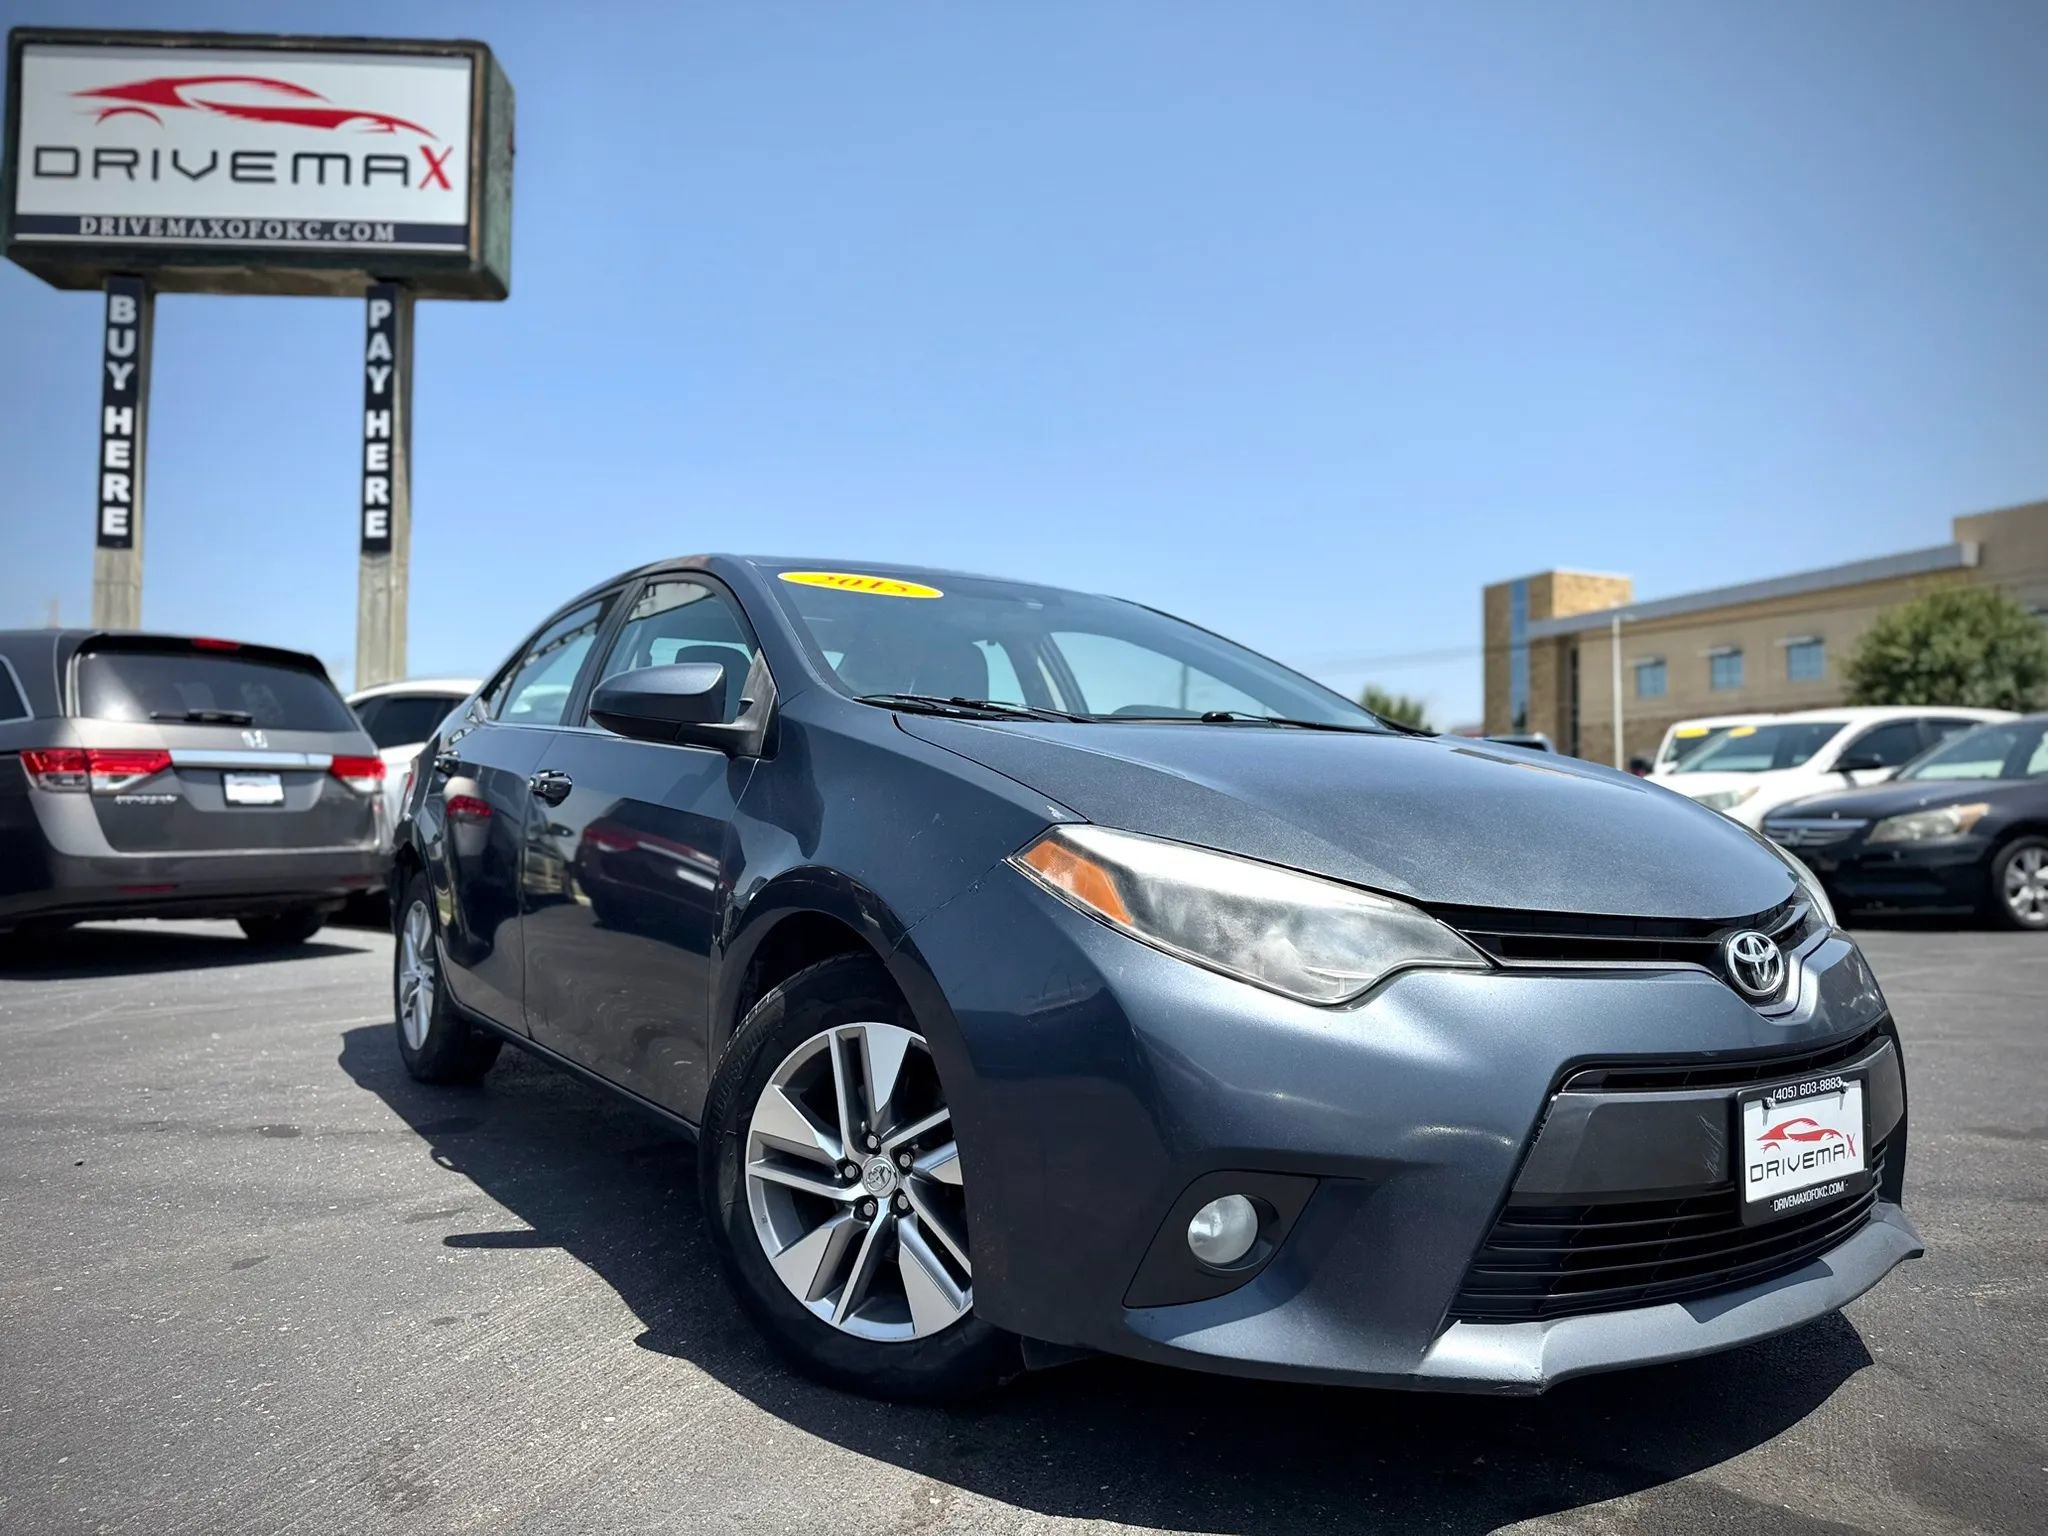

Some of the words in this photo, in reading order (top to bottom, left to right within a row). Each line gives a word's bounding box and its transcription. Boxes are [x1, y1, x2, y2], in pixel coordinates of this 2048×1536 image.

[34, 144, 454, 191] DRIVEMAX
[79, 215, 396, 242] DRIVEMAXOFOKC.COM
[106, 295, 137, 390] BUY
[367, 299, 392, 394] PAY
[102, 406, 133, 536] HERE
[364, 409, 391, 538] HERE
[1772, 1085, 1797, 1101] (405)
[1799, 1076, 1842, 1096] 603-8883
